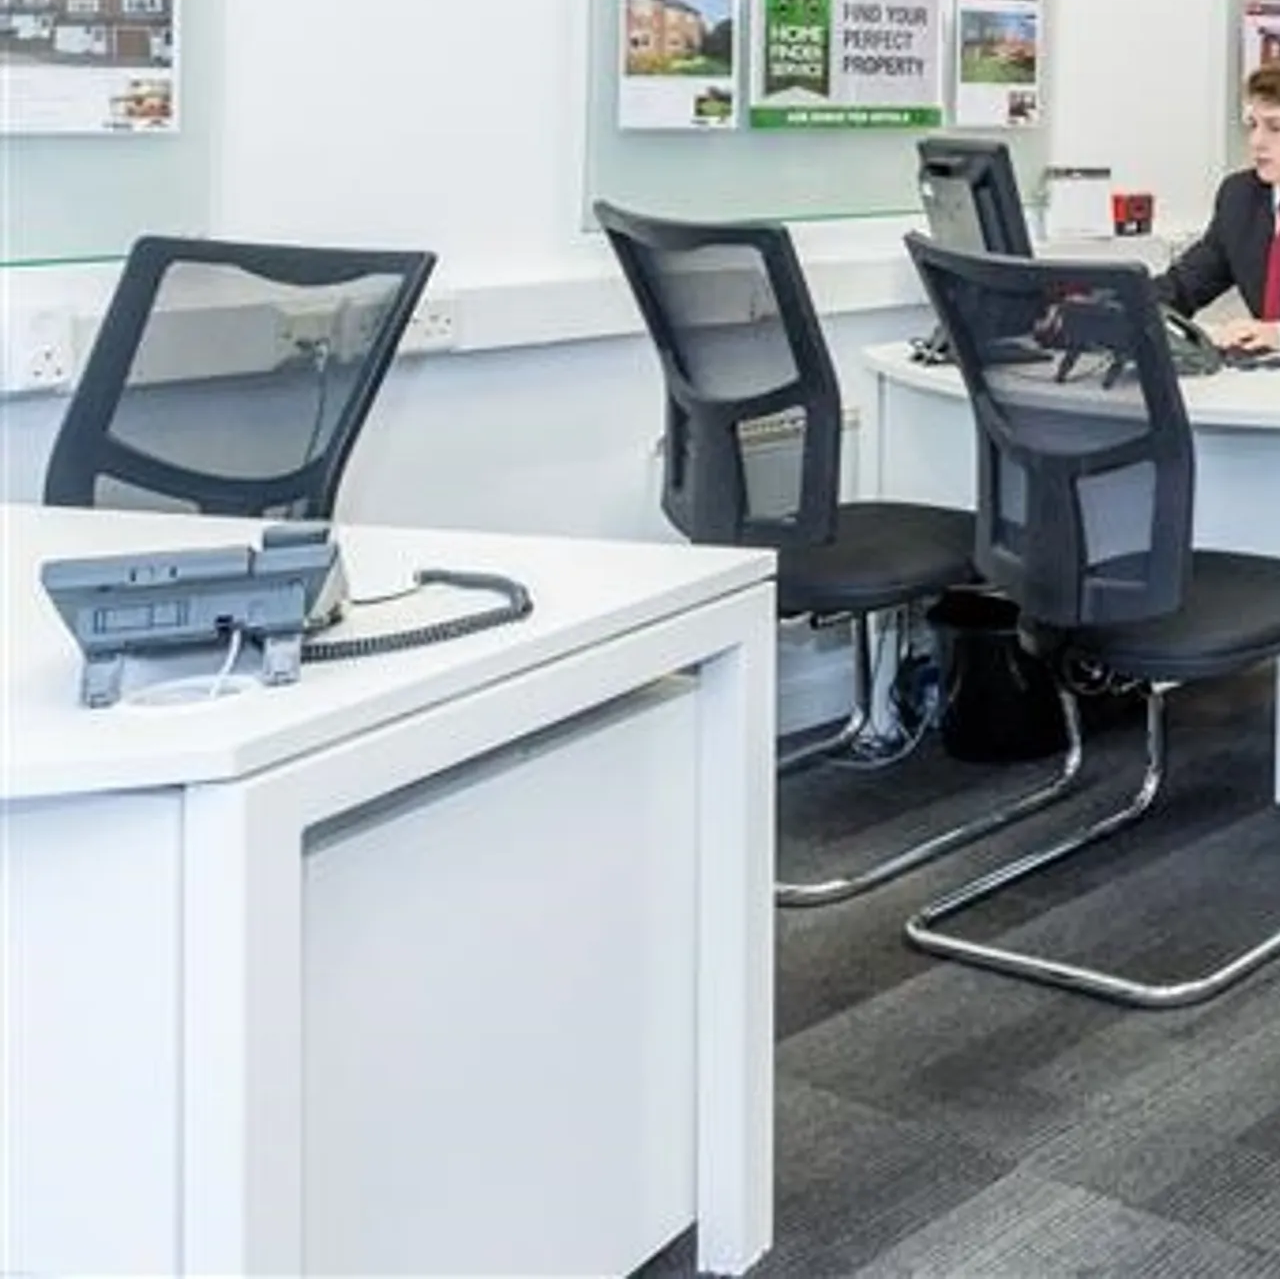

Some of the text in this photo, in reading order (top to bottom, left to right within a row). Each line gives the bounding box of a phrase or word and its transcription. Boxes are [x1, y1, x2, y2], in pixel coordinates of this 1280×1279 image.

[843, 2, 928, 25] FIND YOUR
[769, 26, 824, 42] HOME
[843, 29, 913, 50] PERFECT
[769, 45, 823, 61] FINDER
[843, 55, 925, 76] PROPERTY
